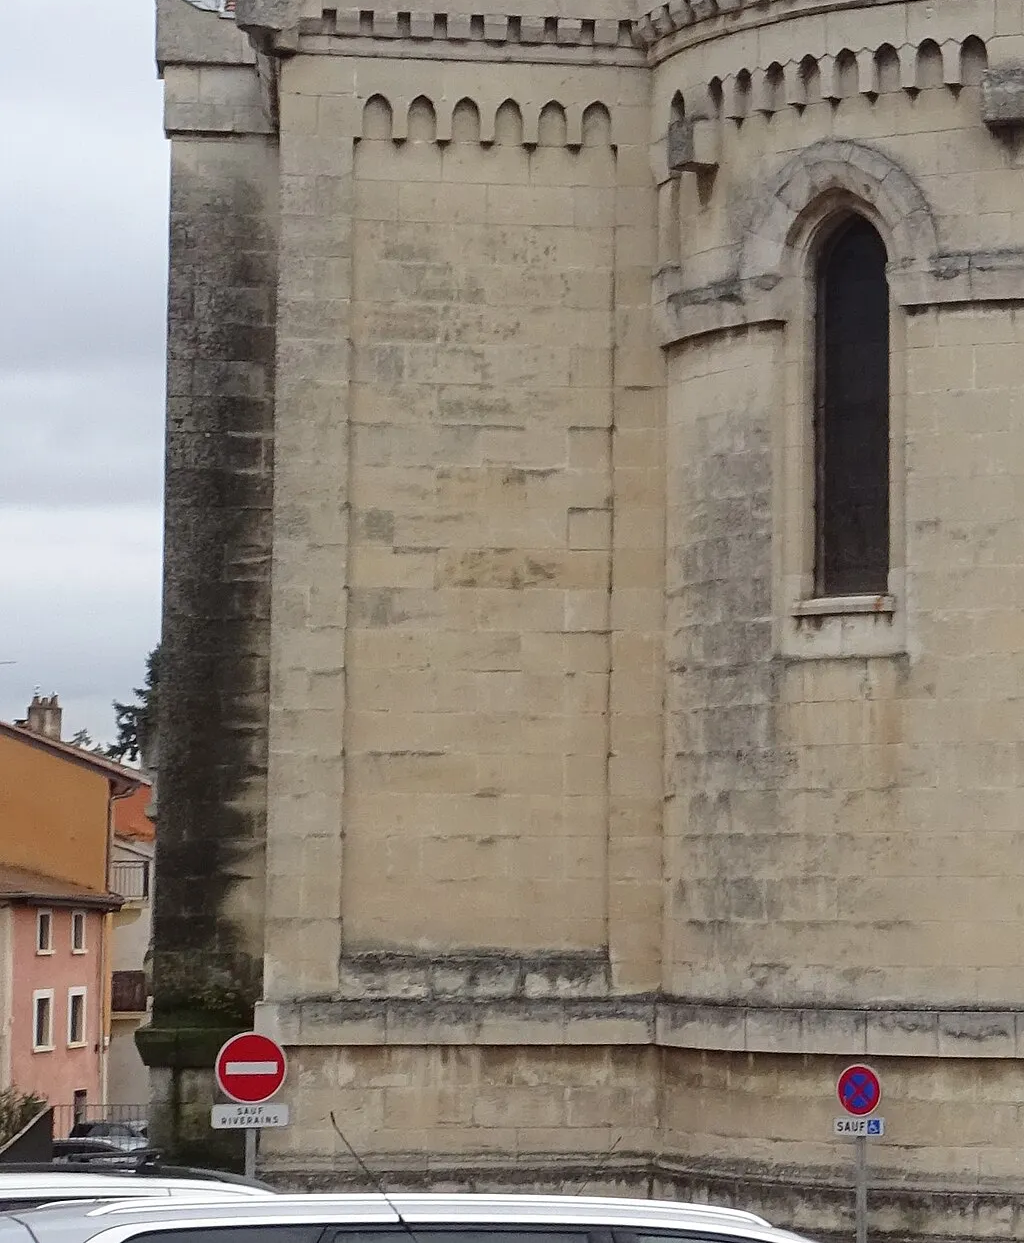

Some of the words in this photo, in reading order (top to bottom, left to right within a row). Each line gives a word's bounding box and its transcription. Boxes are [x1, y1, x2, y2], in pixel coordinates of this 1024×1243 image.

[237, 1106, 264, 1115] SAUF
[221, 1116, 279, 1125] RIVERAINS
[837, 1121, 865, 1132] SAUF
